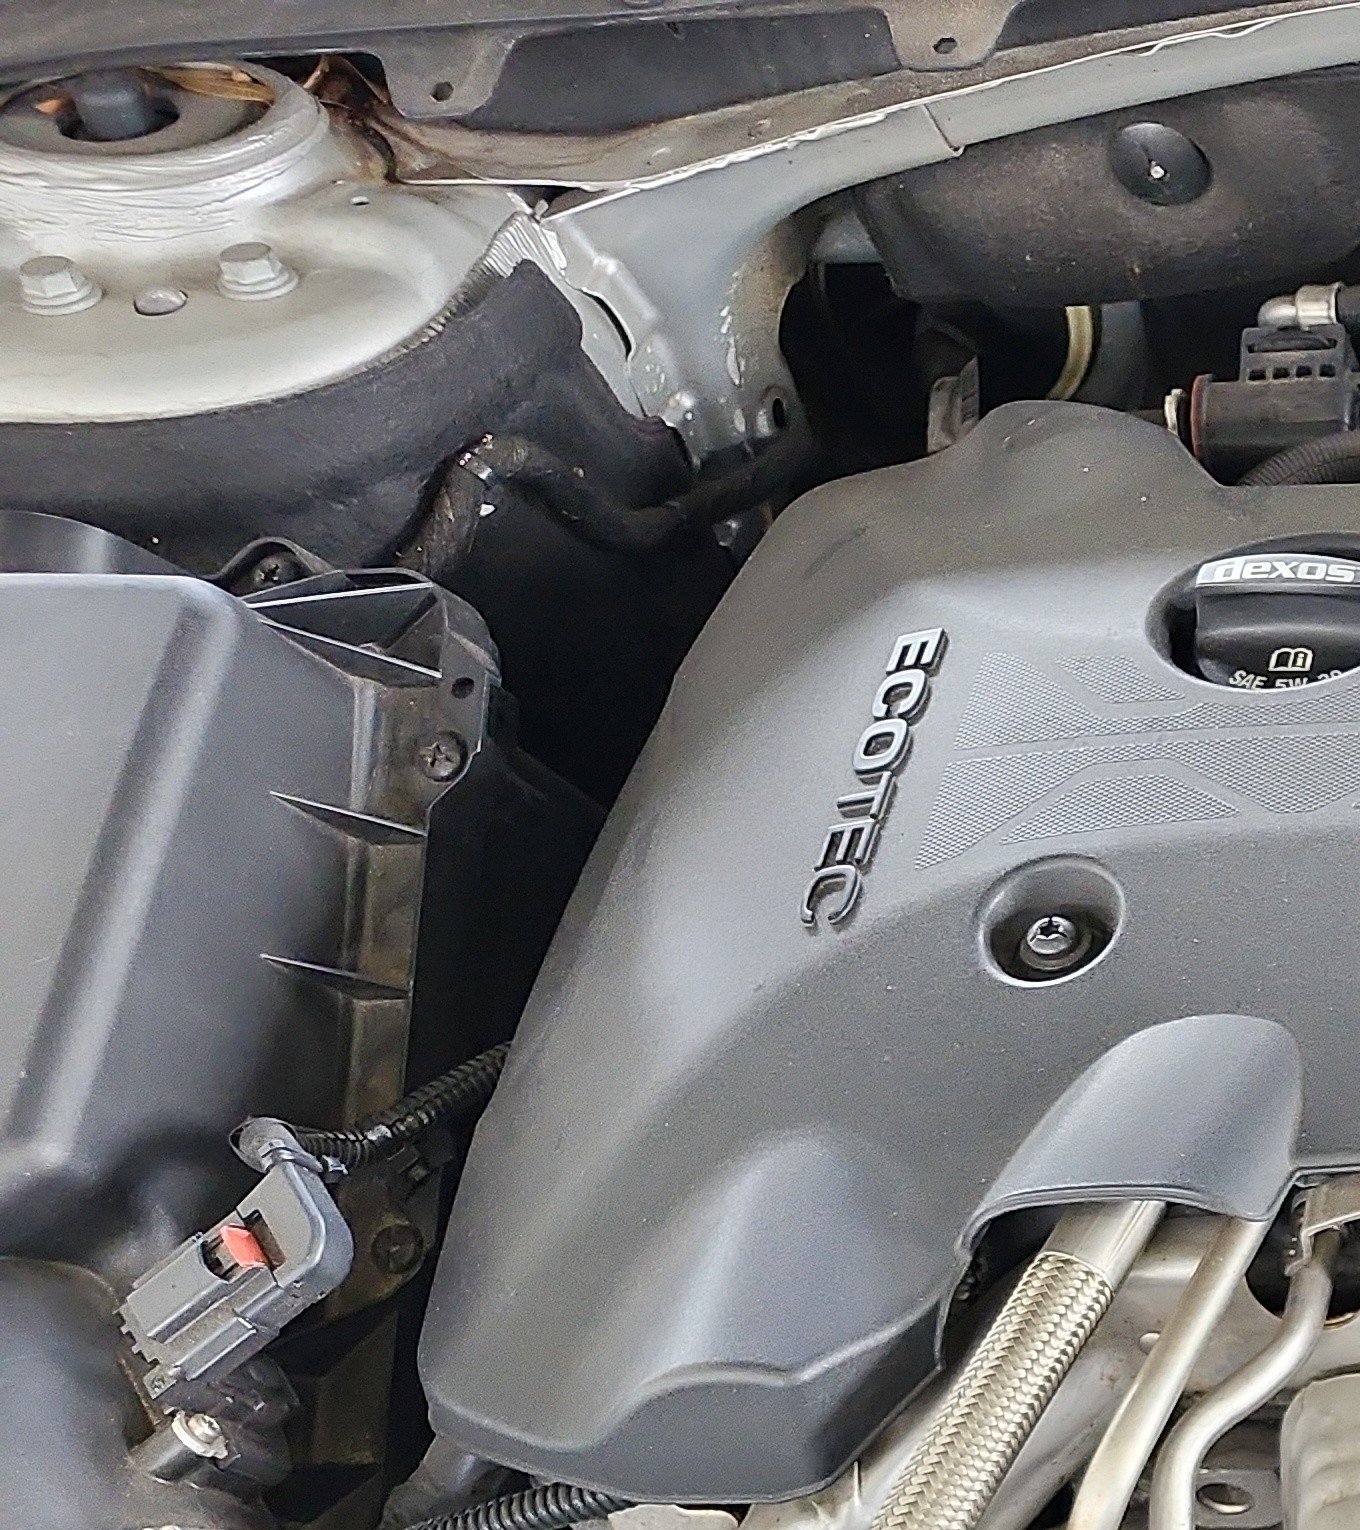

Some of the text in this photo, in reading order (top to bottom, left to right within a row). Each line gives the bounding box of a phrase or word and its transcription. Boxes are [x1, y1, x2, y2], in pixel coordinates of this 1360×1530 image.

[1213, 556, 1356, 583] dexos
[1229, 669, 1267, 690] SAE
[800, 628, 946, 926] ECOTEC
